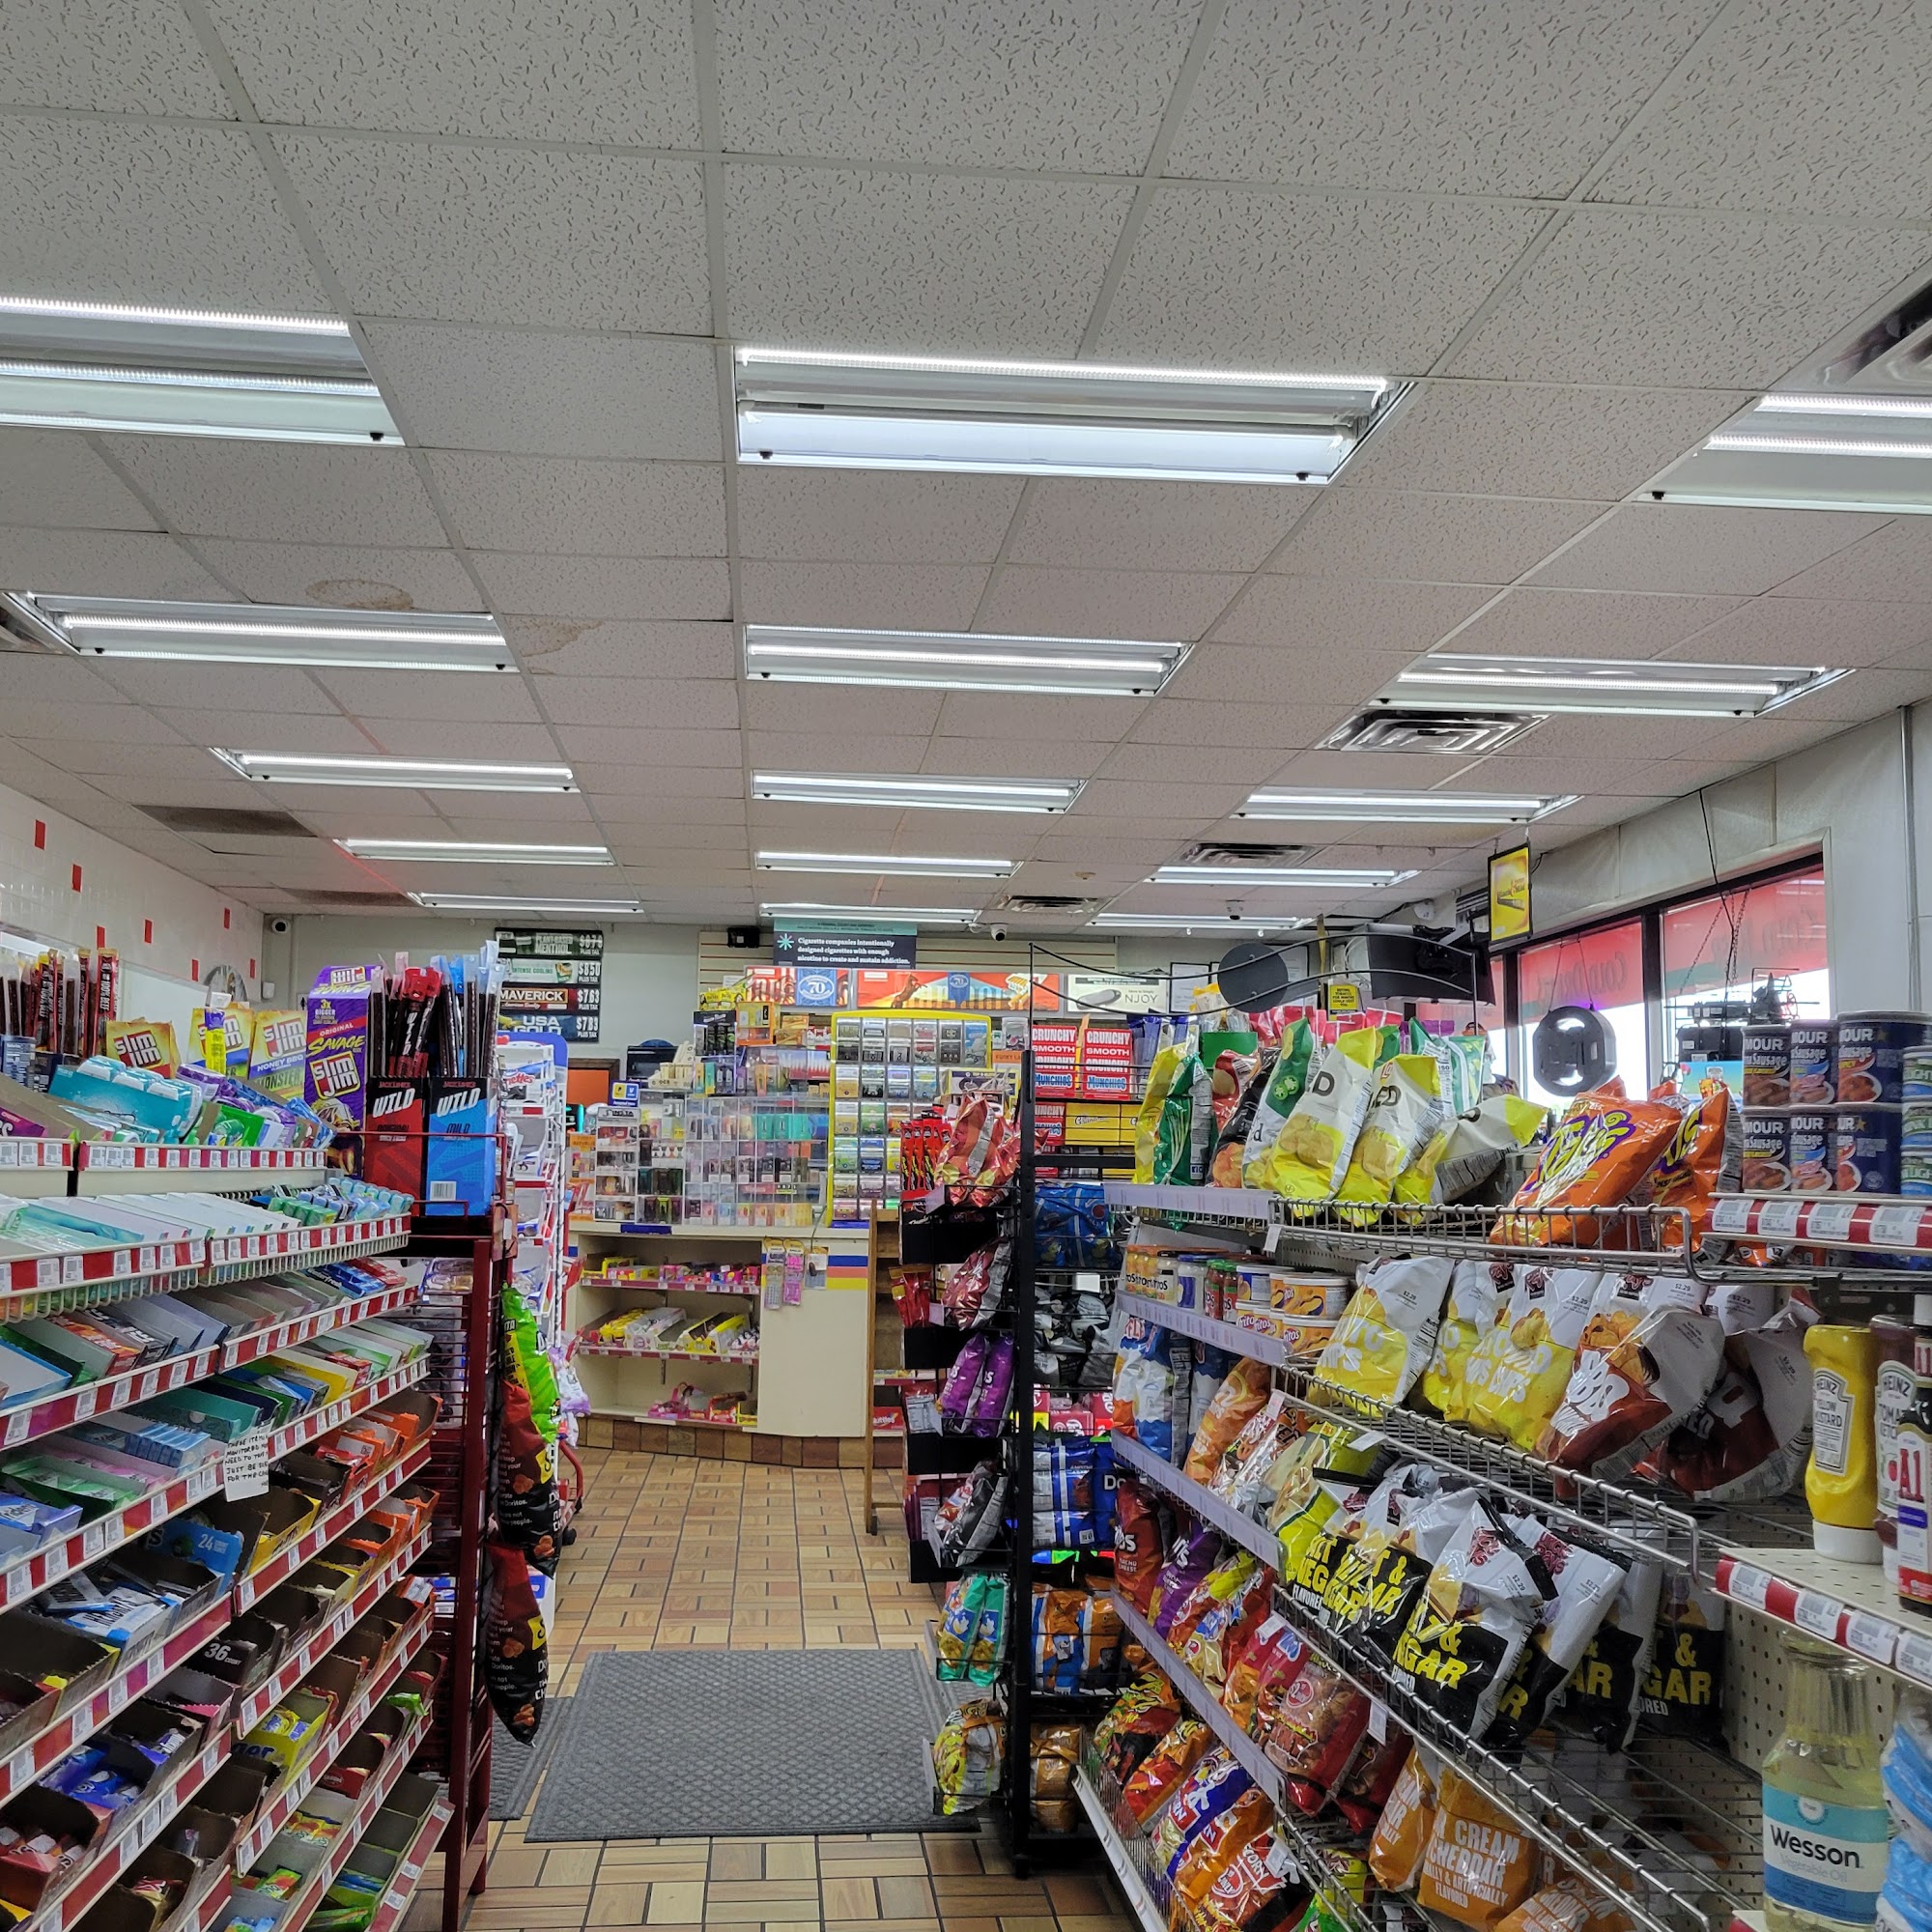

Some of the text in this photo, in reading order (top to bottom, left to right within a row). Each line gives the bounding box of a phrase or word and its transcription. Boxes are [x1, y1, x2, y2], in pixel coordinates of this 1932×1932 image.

[797, 946, 824, 954] designed
[826, 939, 856, 948] companies
[857, 939, 895, 949] intentionally
[500, 990, 563, 1001] MAVERICK
[809, 981, 826, 993] 70
[1124, 994, 1158, 1004] NJOY
[523, 1015, 560, 1026] USA
[319, 1022, 355, 1037] ORIGINAL
[1032, 1029, 1075, 1042] CRUNCHY
[1086, 1031, 1130, 1044] CRUNCHY
[1745, 1038, 1784, 1051] MOUR
[257, 1058, 286, 1072] HONEY
[286, 1054, 304, 1065] BBQ
[373, 1088, 416, 1119] WILD
[437, 1088, 481, 1118] WILD
[1744, 1122, 1785, 1134] MOUR
[1816, 1377, 1838, 1395] HEINZ
[1884, 1374, 1910, 1398] HEINZ
[1880, 1404, 1903, 1426] TOMA
[225, 1457, 242, 1465] NEED
[226, 1465, 244, 1475] JUST
[227, 1474, 240, 1483] FOR
[198, 1533, 213, 1550] 24
[1293, 1584, 1322, 1610] FLAVORE
[1439, 1621, 1463, 1656] &
[204, 1643, 232, 1661] 36
[1675, 1633, 1697, 1668] &
[1455, 1819, 1520, 1864] CREAM
[1770, 1824, 1861, 1869] Wesson
[1780, 1854, 1848, 1883] Vegetable Oil
[1435, 1883, 1469, 1909] FLAVORED
